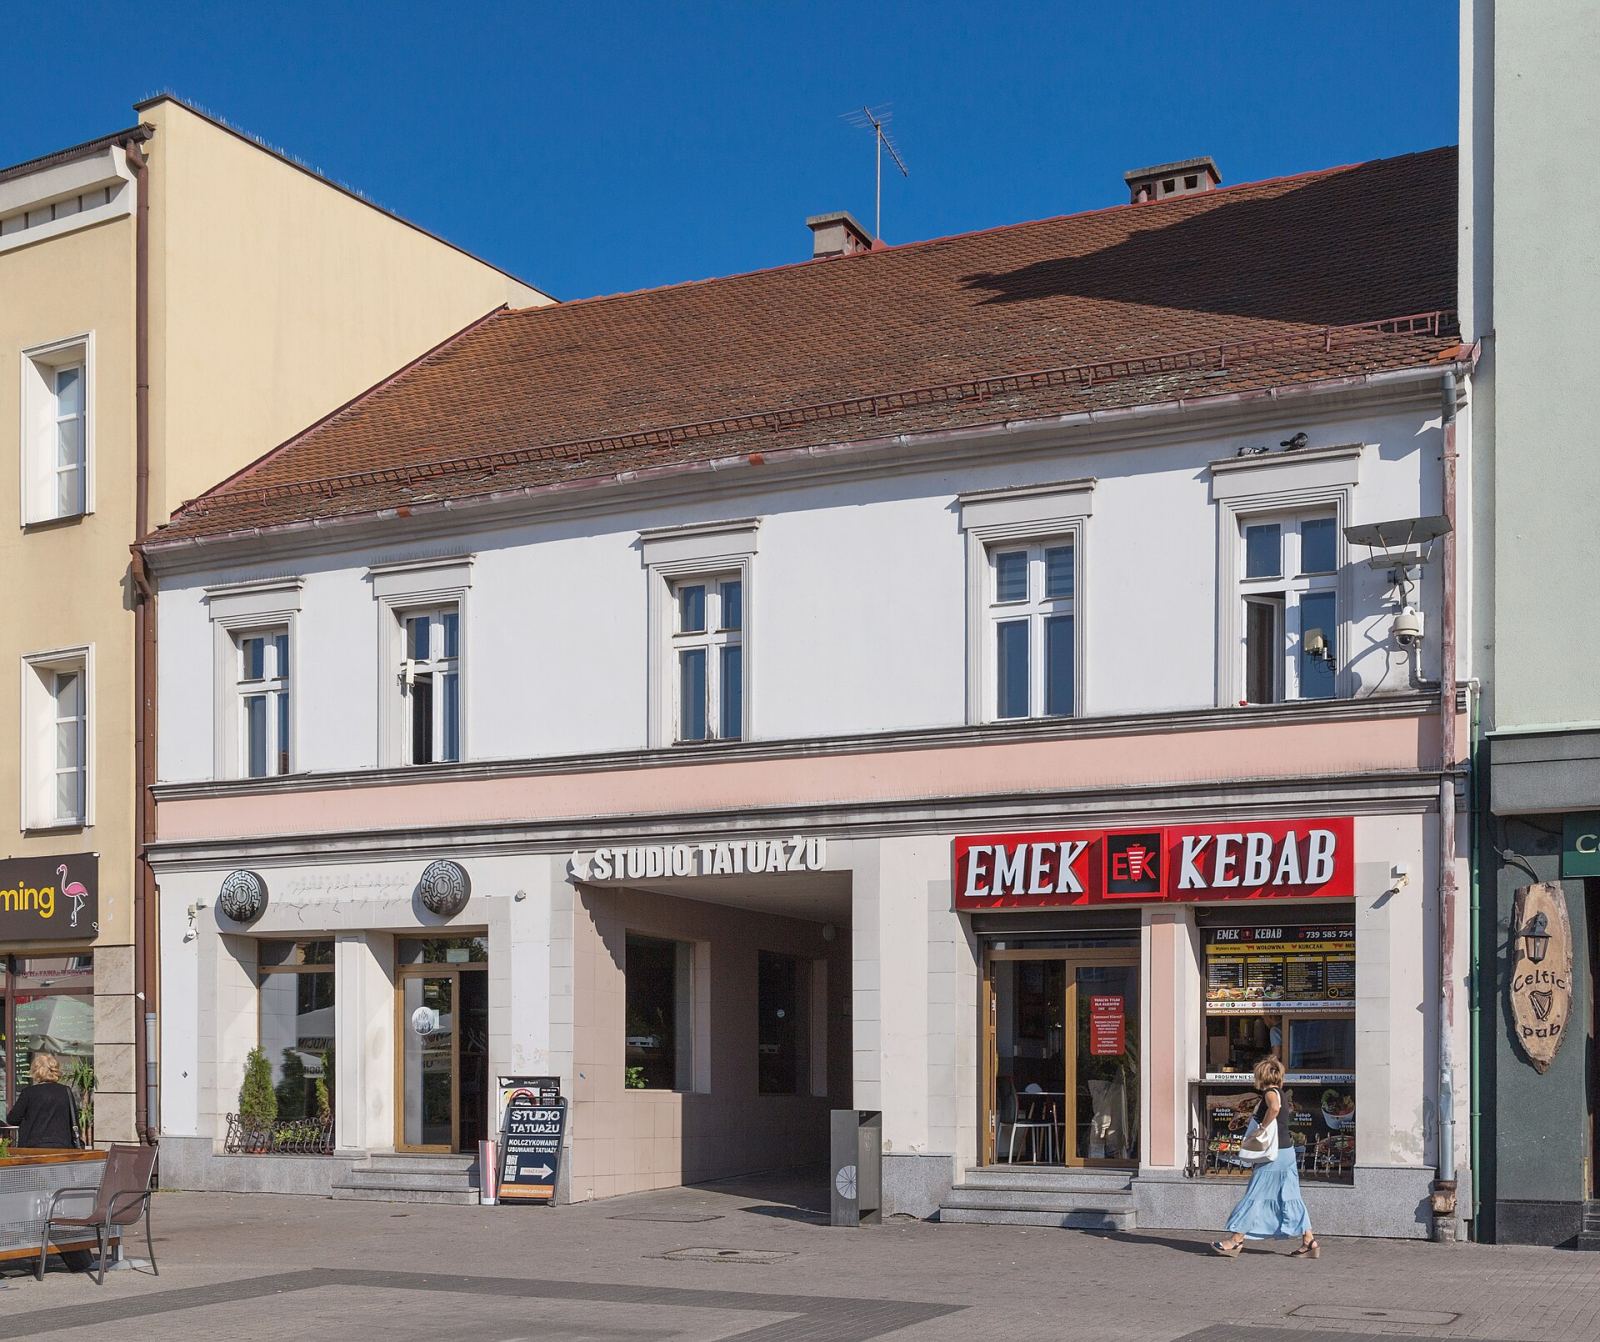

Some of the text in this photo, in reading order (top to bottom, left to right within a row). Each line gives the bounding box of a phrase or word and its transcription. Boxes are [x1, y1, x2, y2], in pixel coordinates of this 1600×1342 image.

[1575, 833, 1600, 854] C
[593, 834, 827, 880] STUDIO TATUAŻU
[964, 841, 1088, 897] EMEK
[1177, 829, 1336, 889] KEBAB
[0, 881, 55, 919] ming
[1216, 928, 1282, 940] EMEK KEBAB
[1305, 930, 1353, 939] 739 585 754
[1513, 970, 1566, 992] Celtic
[1522, 1023, 1561, 1039] pub
[511, 1110, 560, 1121] STUDIO
[510, 1121, 560, 1133] TATUAŻU
[508, 1138, 559, 1146] KOLCZYKOWANIE
